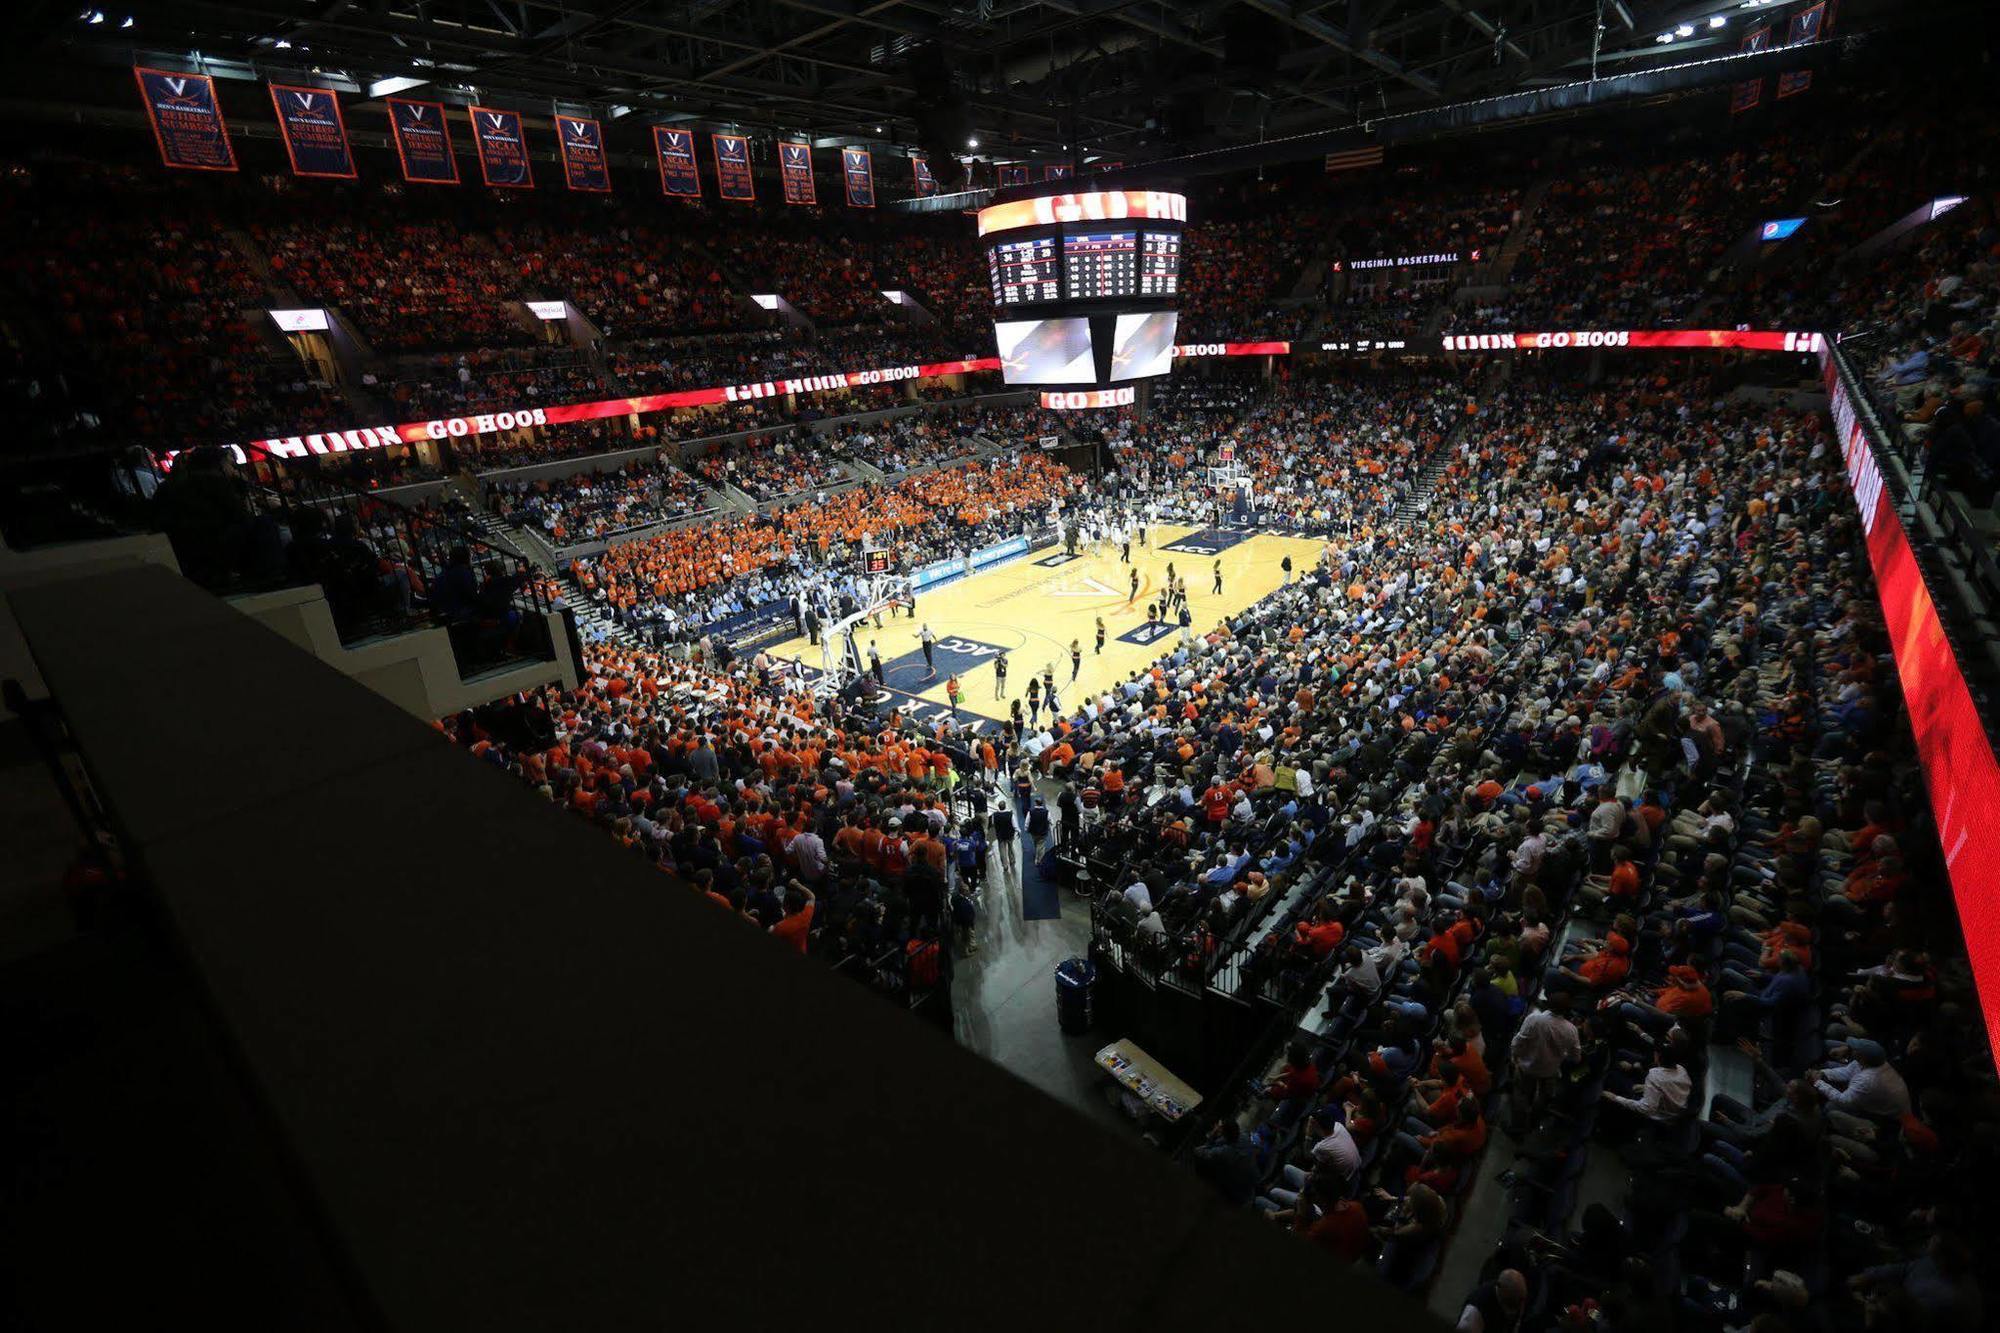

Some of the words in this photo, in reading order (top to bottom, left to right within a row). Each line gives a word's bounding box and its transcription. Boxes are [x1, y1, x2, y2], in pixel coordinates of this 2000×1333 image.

[164, 77, 187, 96] V
[293, 92, 314, 110] V
[408, 104, 425, 121] V
[487, 113, 503, 129] V
[571, 122, 585, 137] V
[667, 132, 679, 146] V
[725, 139, 736, 152] V
[790, 147, 800, 159] V
[1350, 257, 1394, 270] VIRGINIA
[1397, 253, 1459, 266] BASKETBALL
[1536, 332, 1570, 348] GO
[1573, 331, 1629, 347] HOOS
[1184, 344, 1226, 356] HOOS
[859, 371, 880, 385] GO
[882, 366, 920, 383] HOOS
[1049, 392, 1088, 409] GO
[426, 419, 468, 440] GO
[477, 408, 547, 434] HOOS
[871, 559, 885, 570] 35
[936, 639, 1000, 657] ACC
